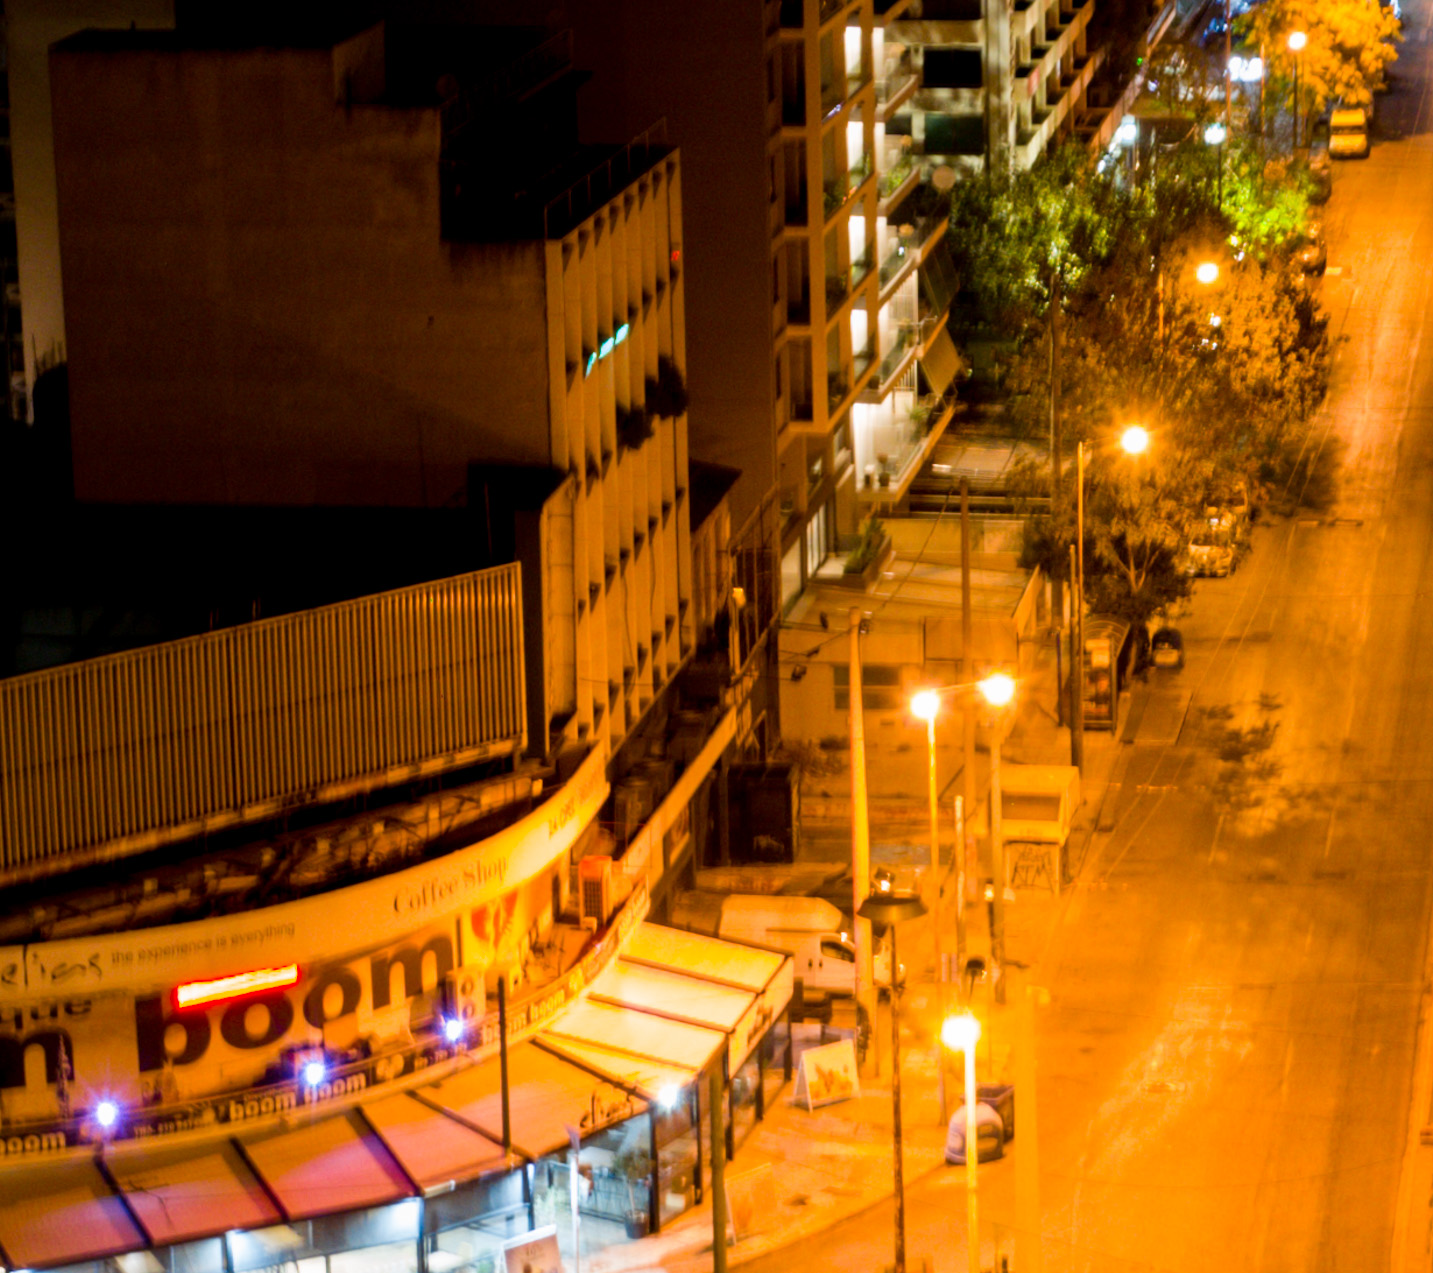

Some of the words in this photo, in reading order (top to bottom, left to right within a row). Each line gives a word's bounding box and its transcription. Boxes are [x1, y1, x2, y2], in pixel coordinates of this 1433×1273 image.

[393, 878, 461, 916] Coffee
[463, 855, 509, 889] Shop
[111, 950, 135, 965] the
[137, 937, 213, 962] experience
[230, 921, 297, 946] everything
[135, 935, 455, 1073] boom
[229, 1090, 297, 1121] boom
